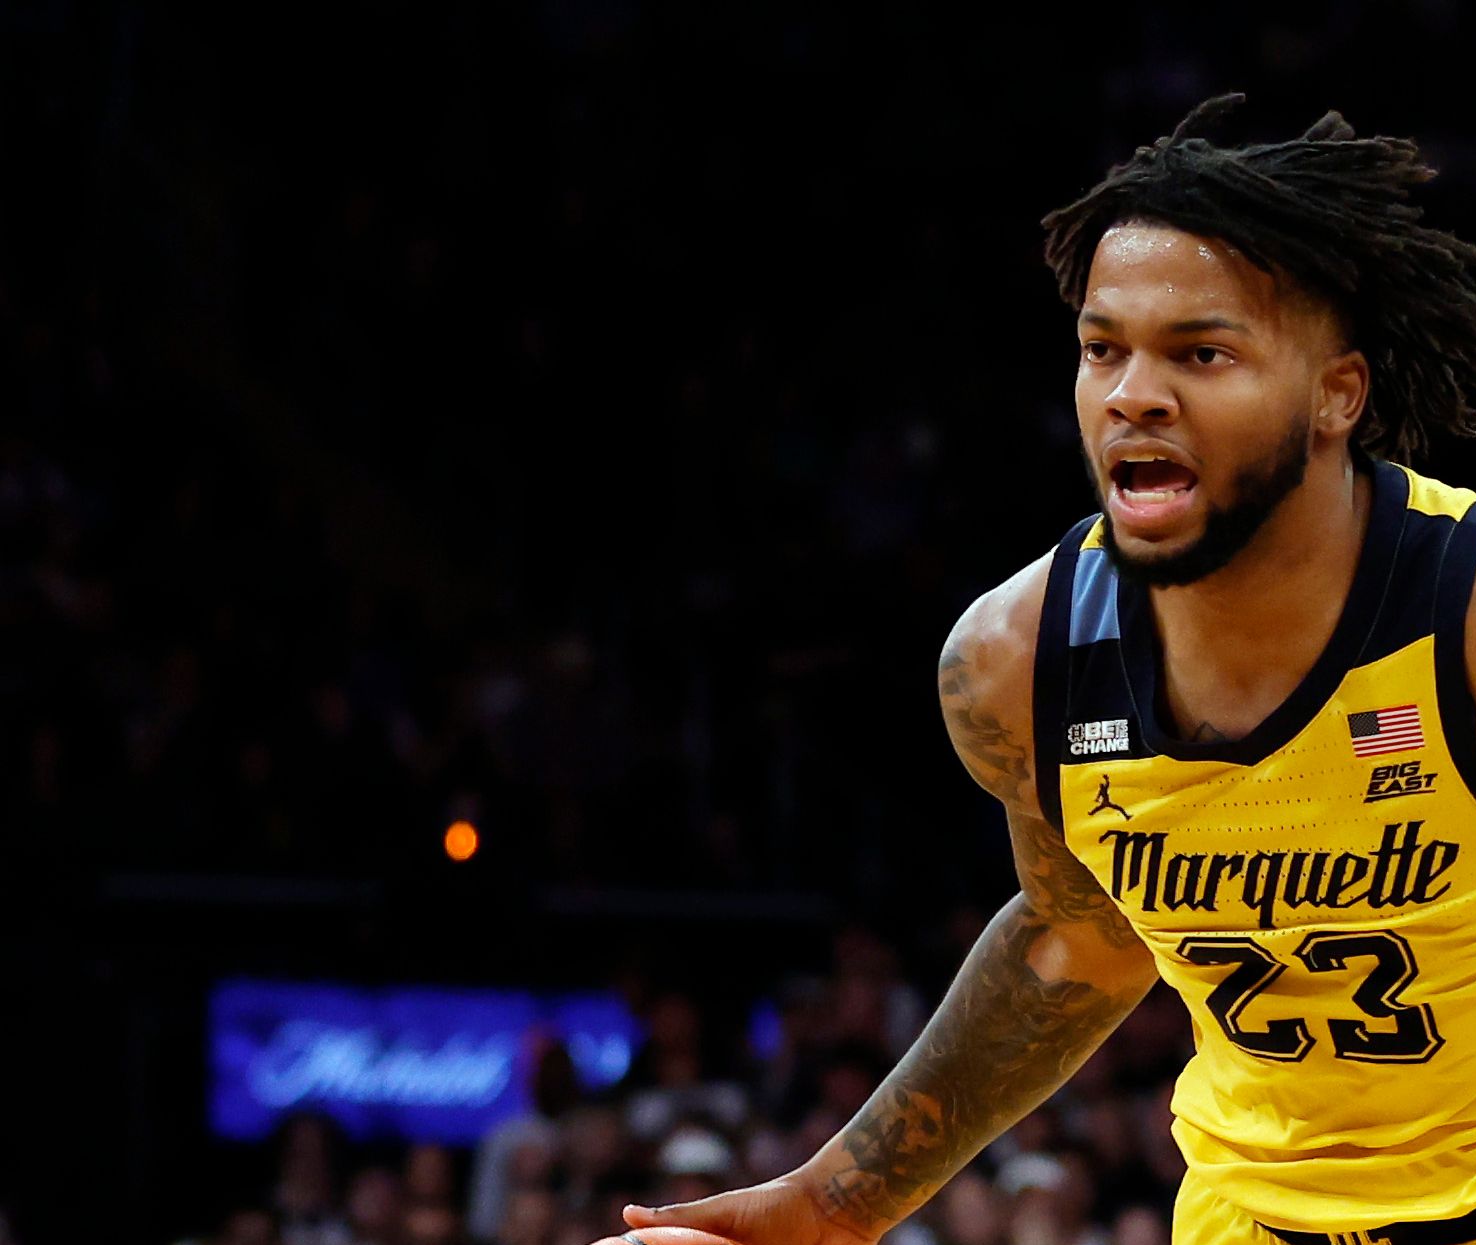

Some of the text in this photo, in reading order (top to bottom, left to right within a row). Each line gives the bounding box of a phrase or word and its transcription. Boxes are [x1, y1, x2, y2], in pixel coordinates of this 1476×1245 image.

[1366, 773, 1438, 796] EAST
[1371, 761, 1421, 780] BIG
[1098, 820, 1460, 929] Marquette
[1175, 929, 1447, 1064] 23
